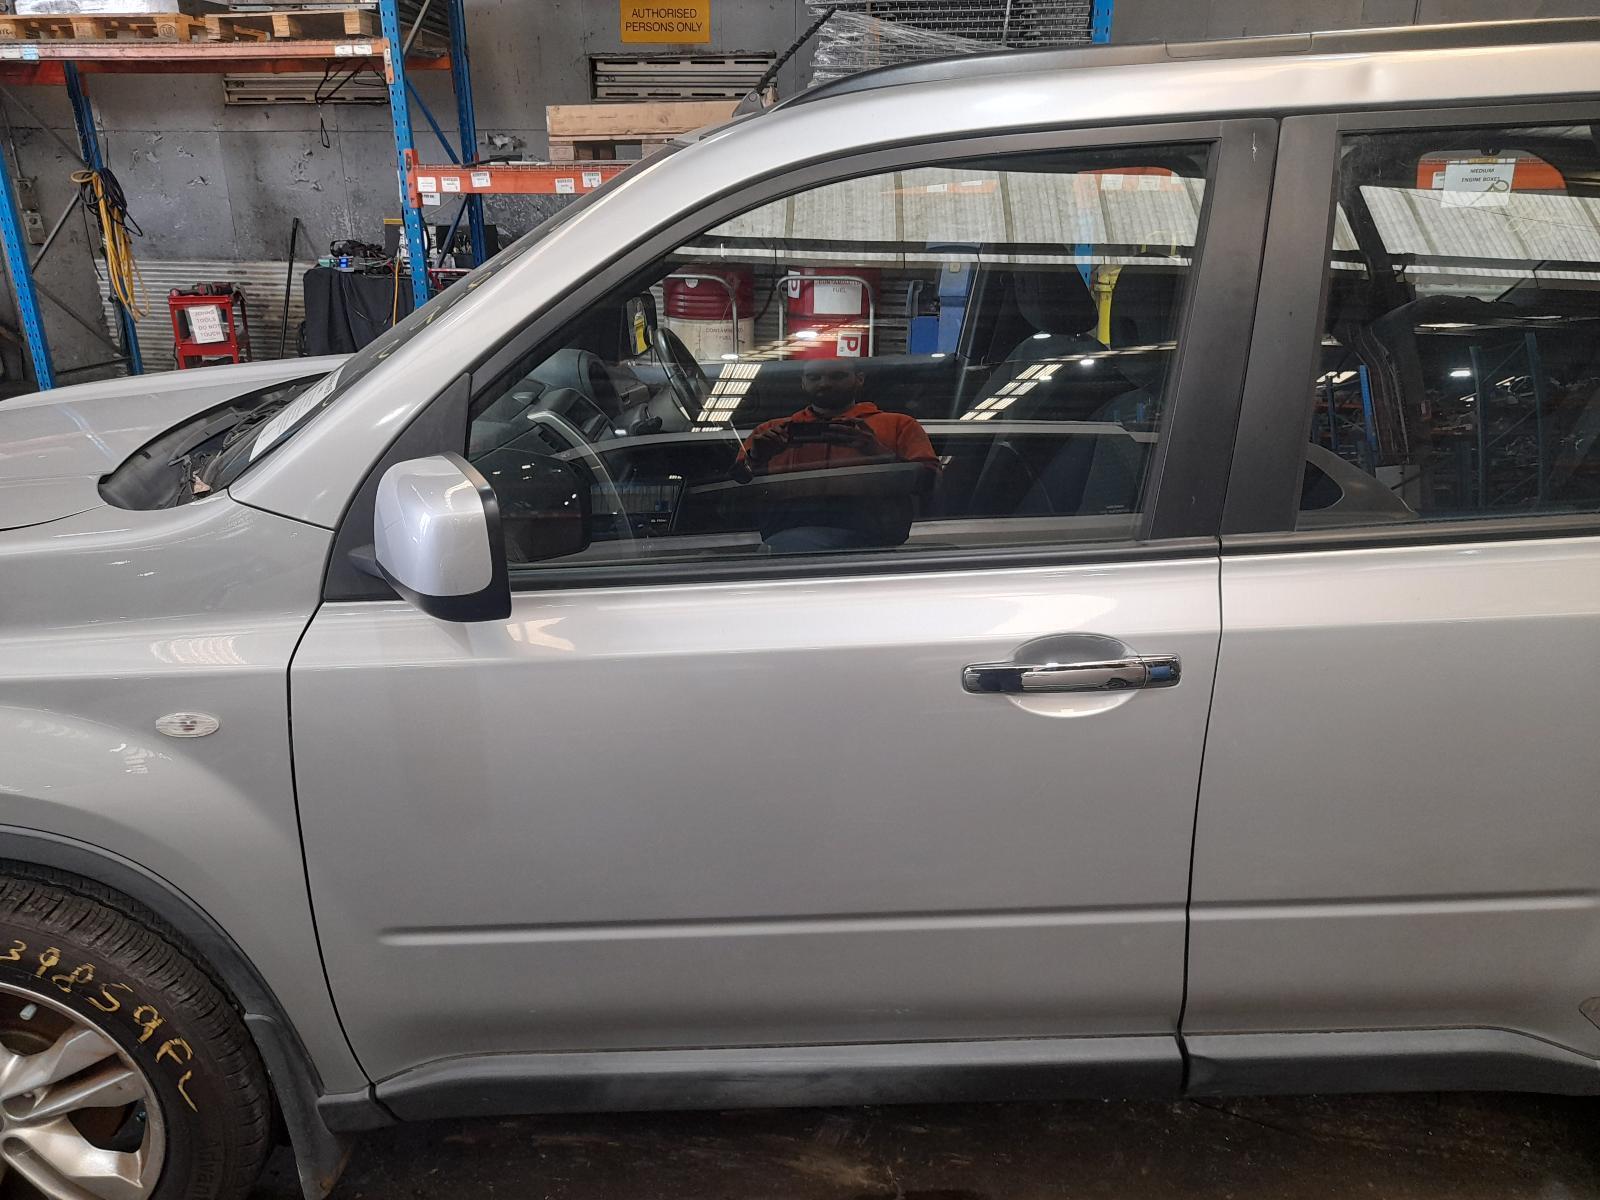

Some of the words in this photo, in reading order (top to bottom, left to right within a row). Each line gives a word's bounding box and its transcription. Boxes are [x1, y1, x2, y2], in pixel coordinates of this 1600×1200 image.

[631, 8, 698, 19] AUTHORISED
[625, 22, 675, 32] PERSONS
[676, 22, 703, 32] ONLY
